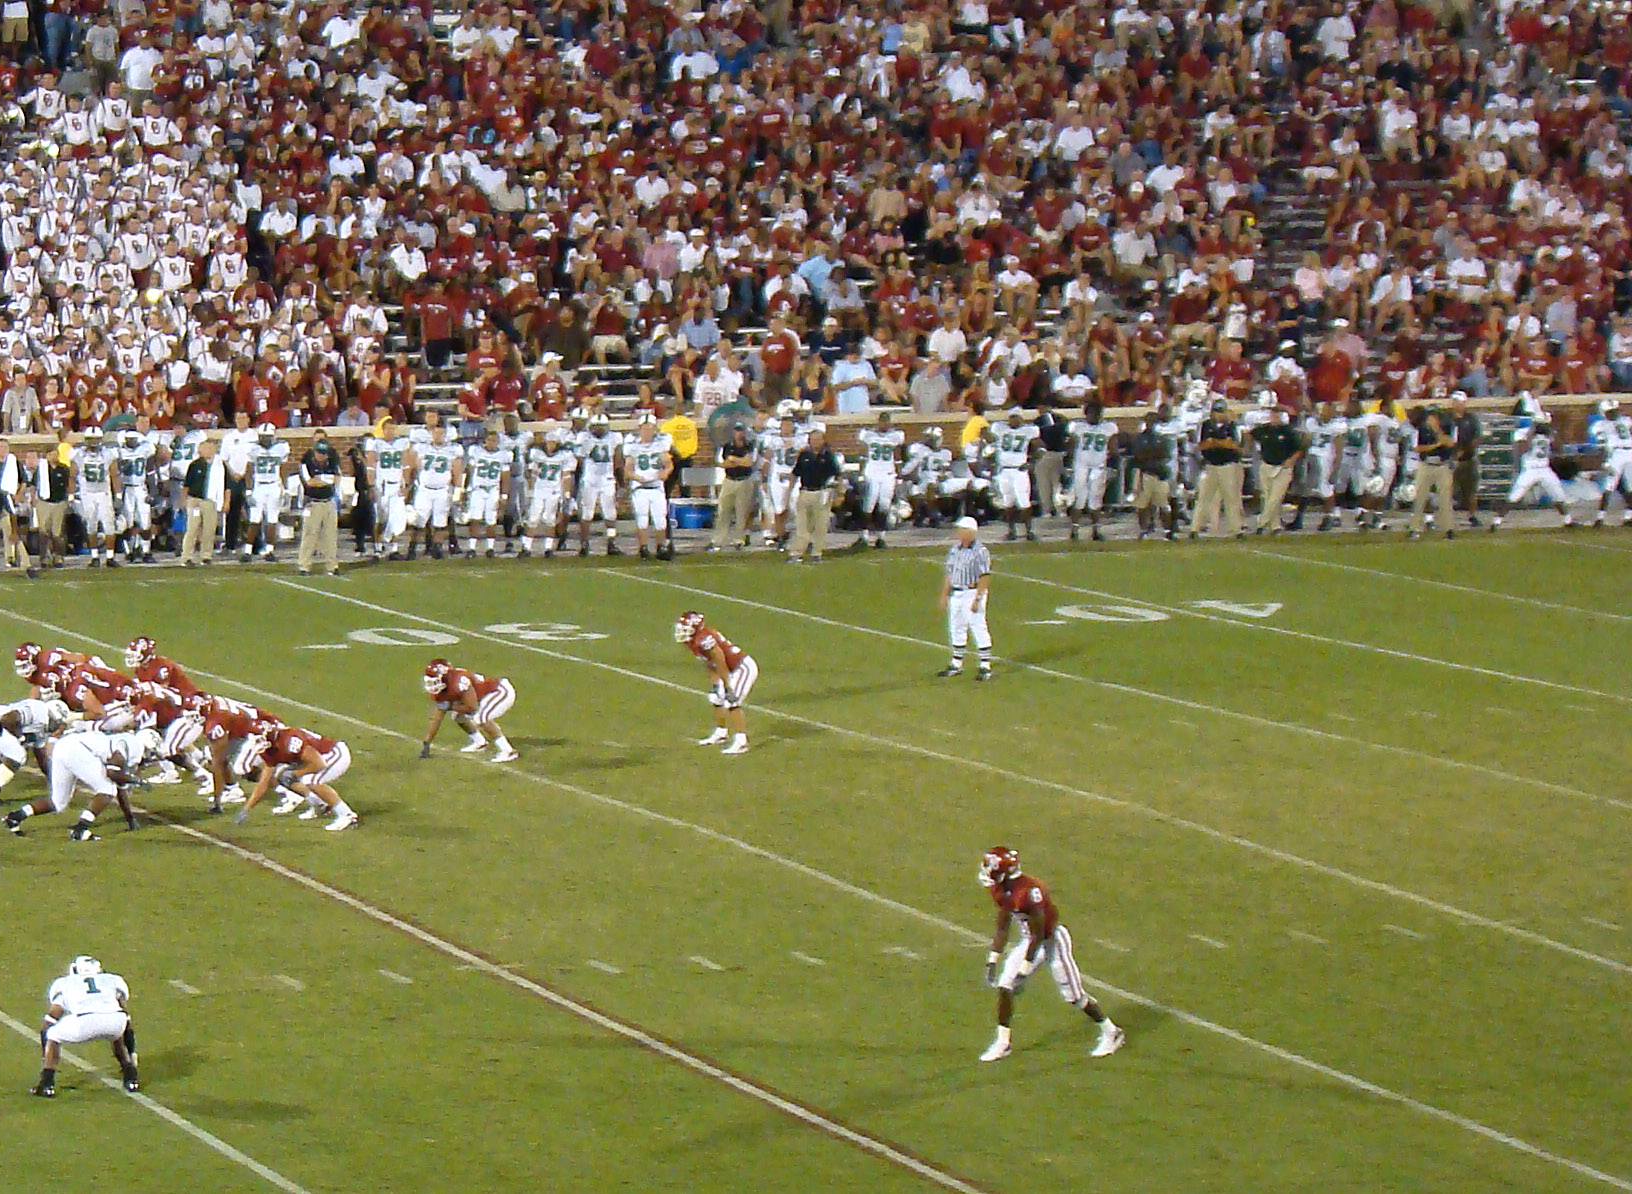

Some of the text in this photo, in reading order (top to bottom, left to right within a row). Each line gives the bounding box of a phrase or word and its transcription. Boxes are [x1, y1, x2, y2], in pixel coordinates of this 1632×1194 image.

[84, 463, 106, 483] 51
[424, 454, 448, 474] 73
[477, 458, 501, 480] 26
[83, 977, 101, 994] 1
